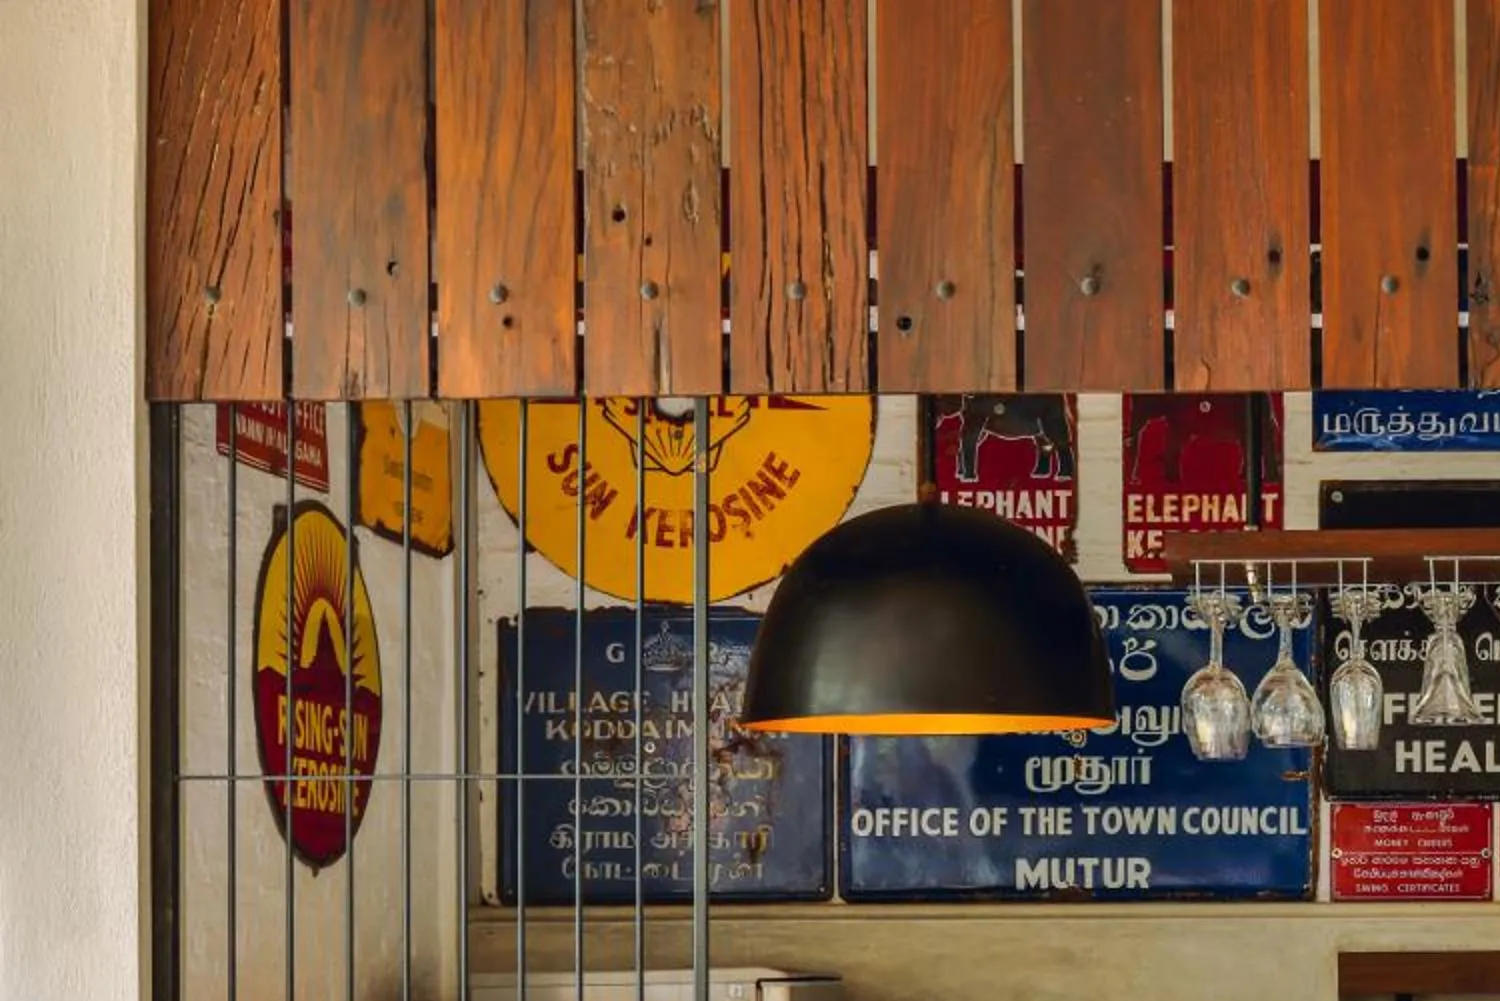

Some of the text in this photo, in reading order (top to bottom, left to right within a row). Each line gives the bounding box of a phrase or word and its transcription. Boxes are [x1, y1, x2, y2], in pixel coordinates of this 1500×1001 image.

[605, 643, 626, 664] G
[851, 806, 1308, 837] OFFICE OF THE TOWN COUNCIL
[1015, 856, 1152, 889] MUTUR
